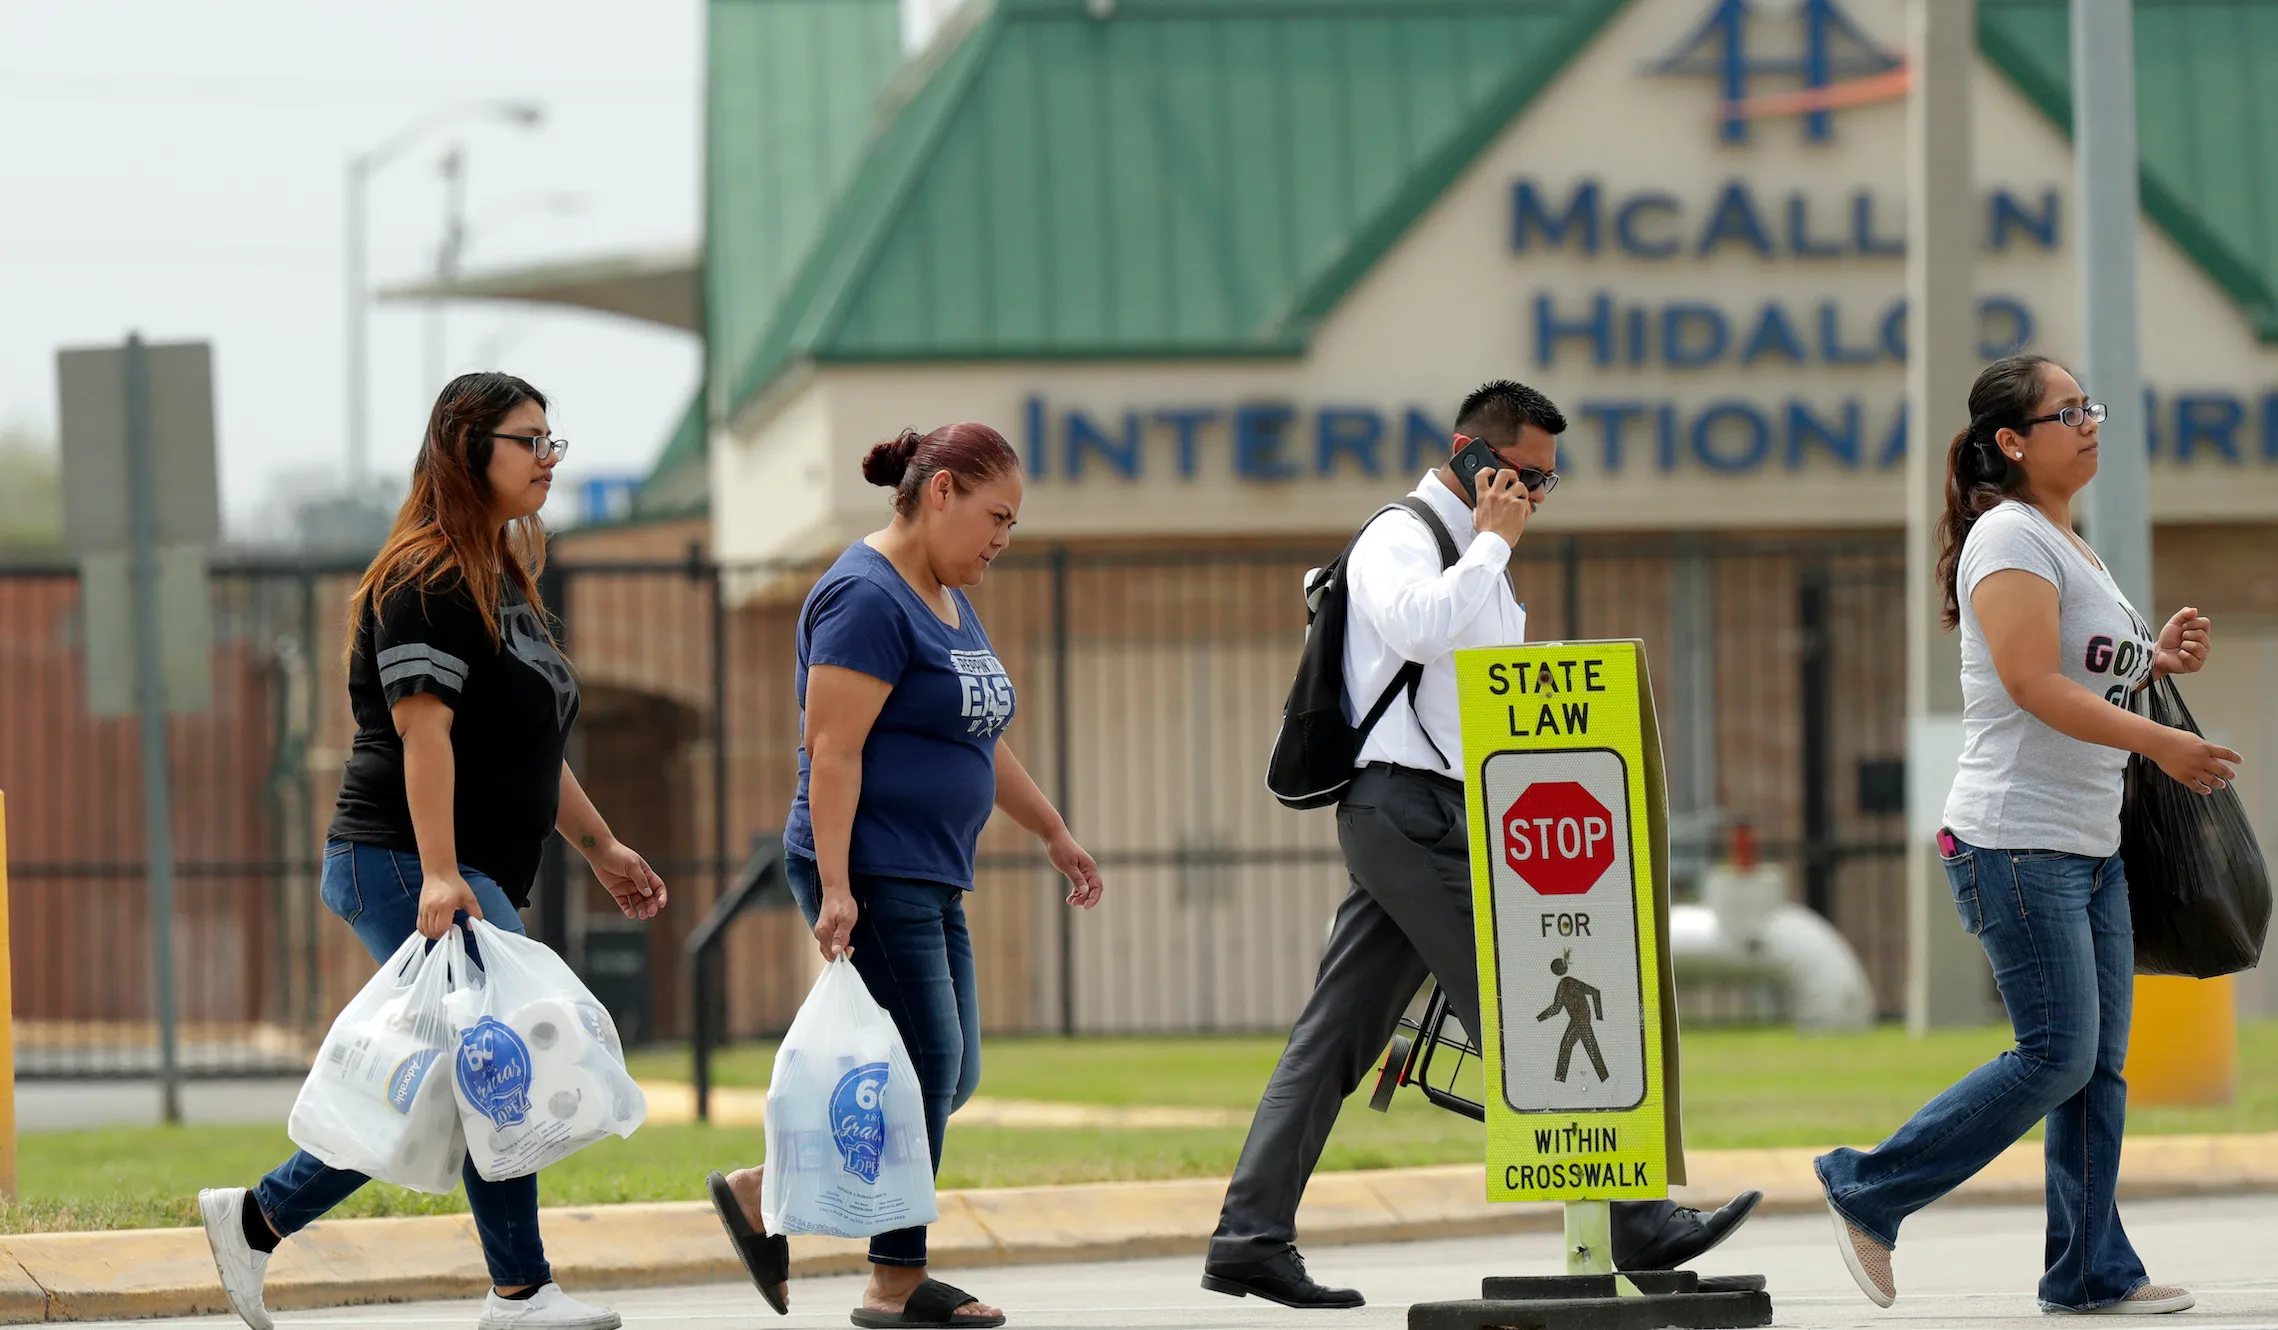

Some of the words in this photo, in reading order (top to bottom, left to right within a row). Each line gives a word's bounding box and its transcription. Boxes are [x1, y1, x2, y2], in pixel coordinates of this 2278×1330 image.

[1511, 178, 2060, 258] MCALLN
[1488, 659, 1606, 695] STATE
[1508, 702, 1589, 737] LAW
[1508, 816, 1608, 861] STOP
[1541, 913, 1592, 938] FOR
[394, 1060, 420, 1105] Adorable
[1535, 1127, 1617, 1156] WITHIN
[1505, 1162, 1648, 1190] CROSSWALK
